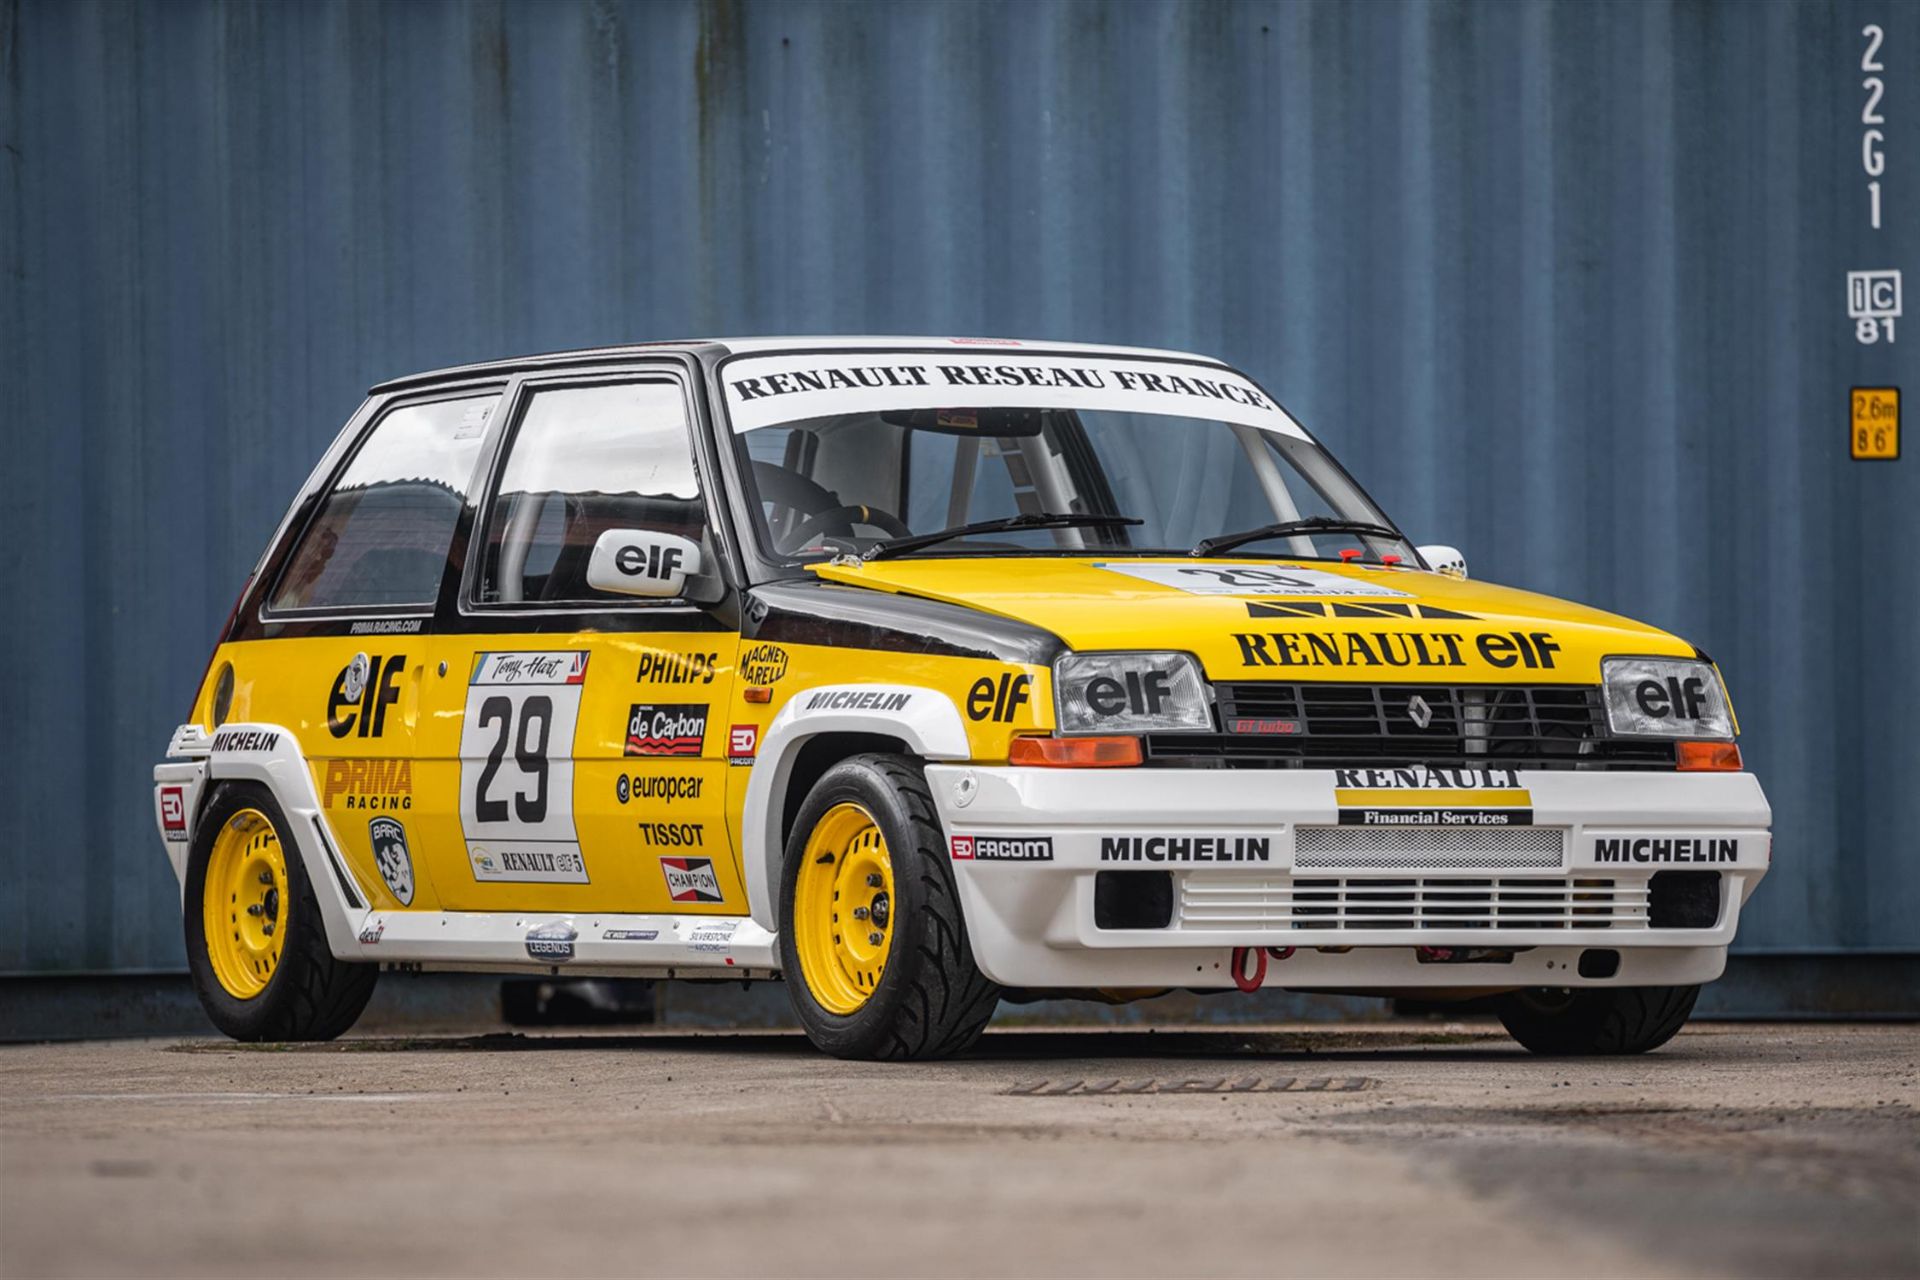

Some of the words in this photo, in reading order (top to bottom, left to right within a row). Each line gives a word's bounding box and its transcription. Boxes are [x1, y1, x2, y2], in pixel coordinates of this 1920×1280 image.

[1856, 317, 1896, 344] 81
[730, 365, 931, 401] RENAULT
[935, 365, 1105, 388] RESEAU
[1110, 370, 1273, 411] FRANCE
[615, 544, 683, 581] elf
[1230, 632, 1468, 667] RENAULT
[1475, 632, 1561, 669] elf
[492, 655, 523, 682] Tony
[523, 656, 564, 679] Hart
[636, 652, 718, 685] PHILIPS
[327, 655, 406, 739] elf
[806, 691, 912, 711] MICHELIN
[966, 673, 1034, 723] elf
[1085, 670, 1173, 717] elf
[1636, 676, 1707, 720] elf
[630, 711, 649, 739] de
[651, 711, 705, 740] Carbon
[211, 731, 280, 752] MICHELIN
[475, 695, 553, 824] 29
[323, 760, 413, 809] PRIMA
[632, 775, 704, 805] europcar
[346, 796, 413, 810] RACING
[1363, 810, 1440, 825] Financial
[1442, 811, 1509, 825] Services
[373, 824, 403, 843] BARC
[639, 823, 704, 847] TISSOT
[977, 839, 1050, 858] FACOM
[1101, 837, 1270, 862] MICHELIN
[1594, 838, 1738, 862] MICHELIN
[501, 853, 556, 872] RENAULT
[573, 854, 583, 873] 5
[668, 873, 716, 888] CHAMPION
[529, 941, 571, 954] LEGENDS
